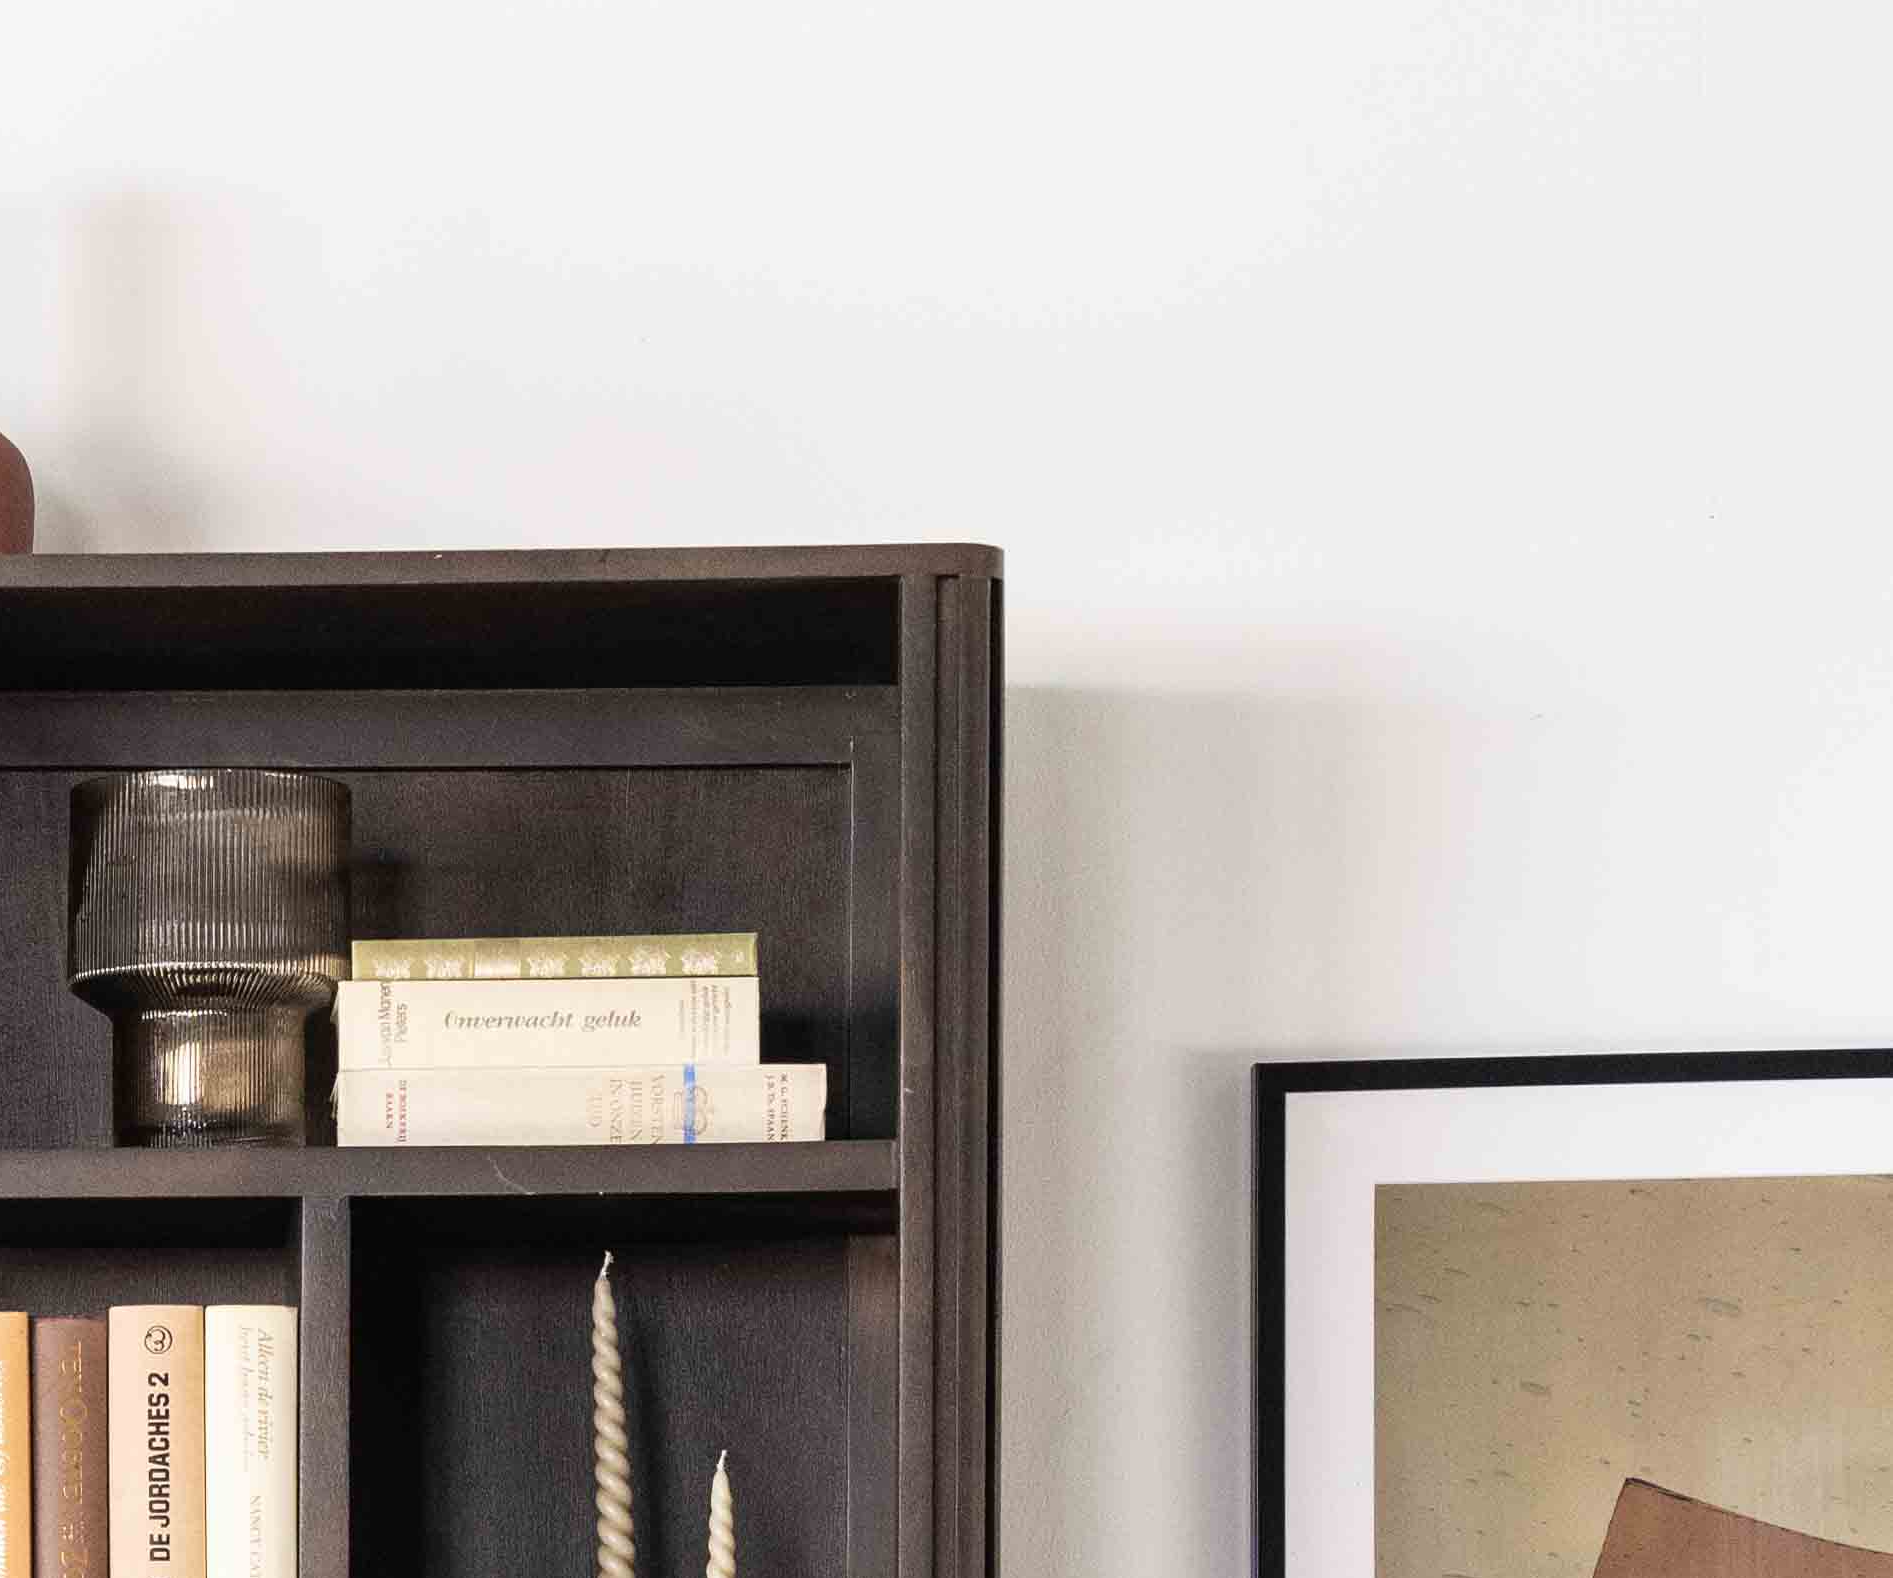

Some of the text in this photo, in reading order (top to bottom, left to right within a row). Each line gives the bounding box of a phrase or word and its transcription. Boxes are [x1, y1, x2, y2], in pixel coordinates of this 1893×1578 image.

[580, 1008, 642, 1031] geluk
[147, 1371, 170, 1388] 2
[147, 1391, 171, 1530] JORDACHES
[149, 1532, 171, 1563] DE
